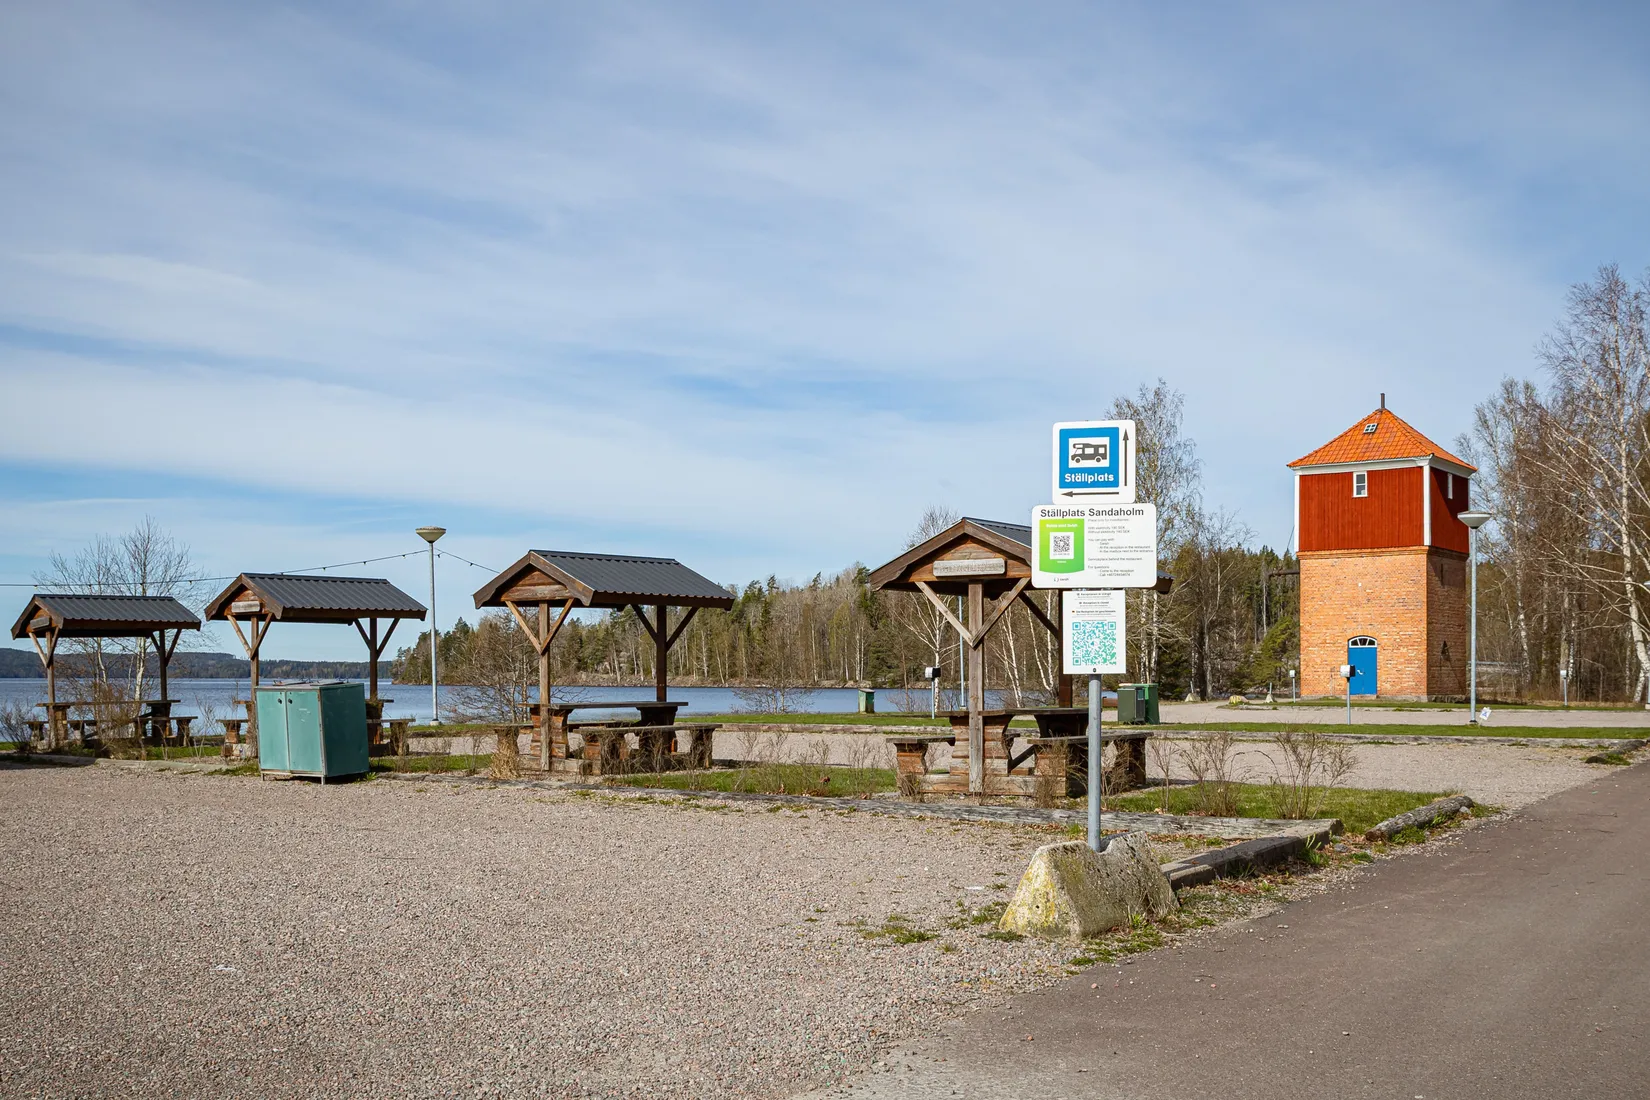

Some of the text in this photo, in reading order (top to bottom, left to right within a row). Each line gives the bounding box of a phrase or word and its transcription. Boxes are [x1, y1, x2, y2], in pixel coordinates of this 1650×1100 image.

[1064, 472, 1114, 484] Ställplats
[1040, 507, 1144, 519] Ställplats Sandaholm
